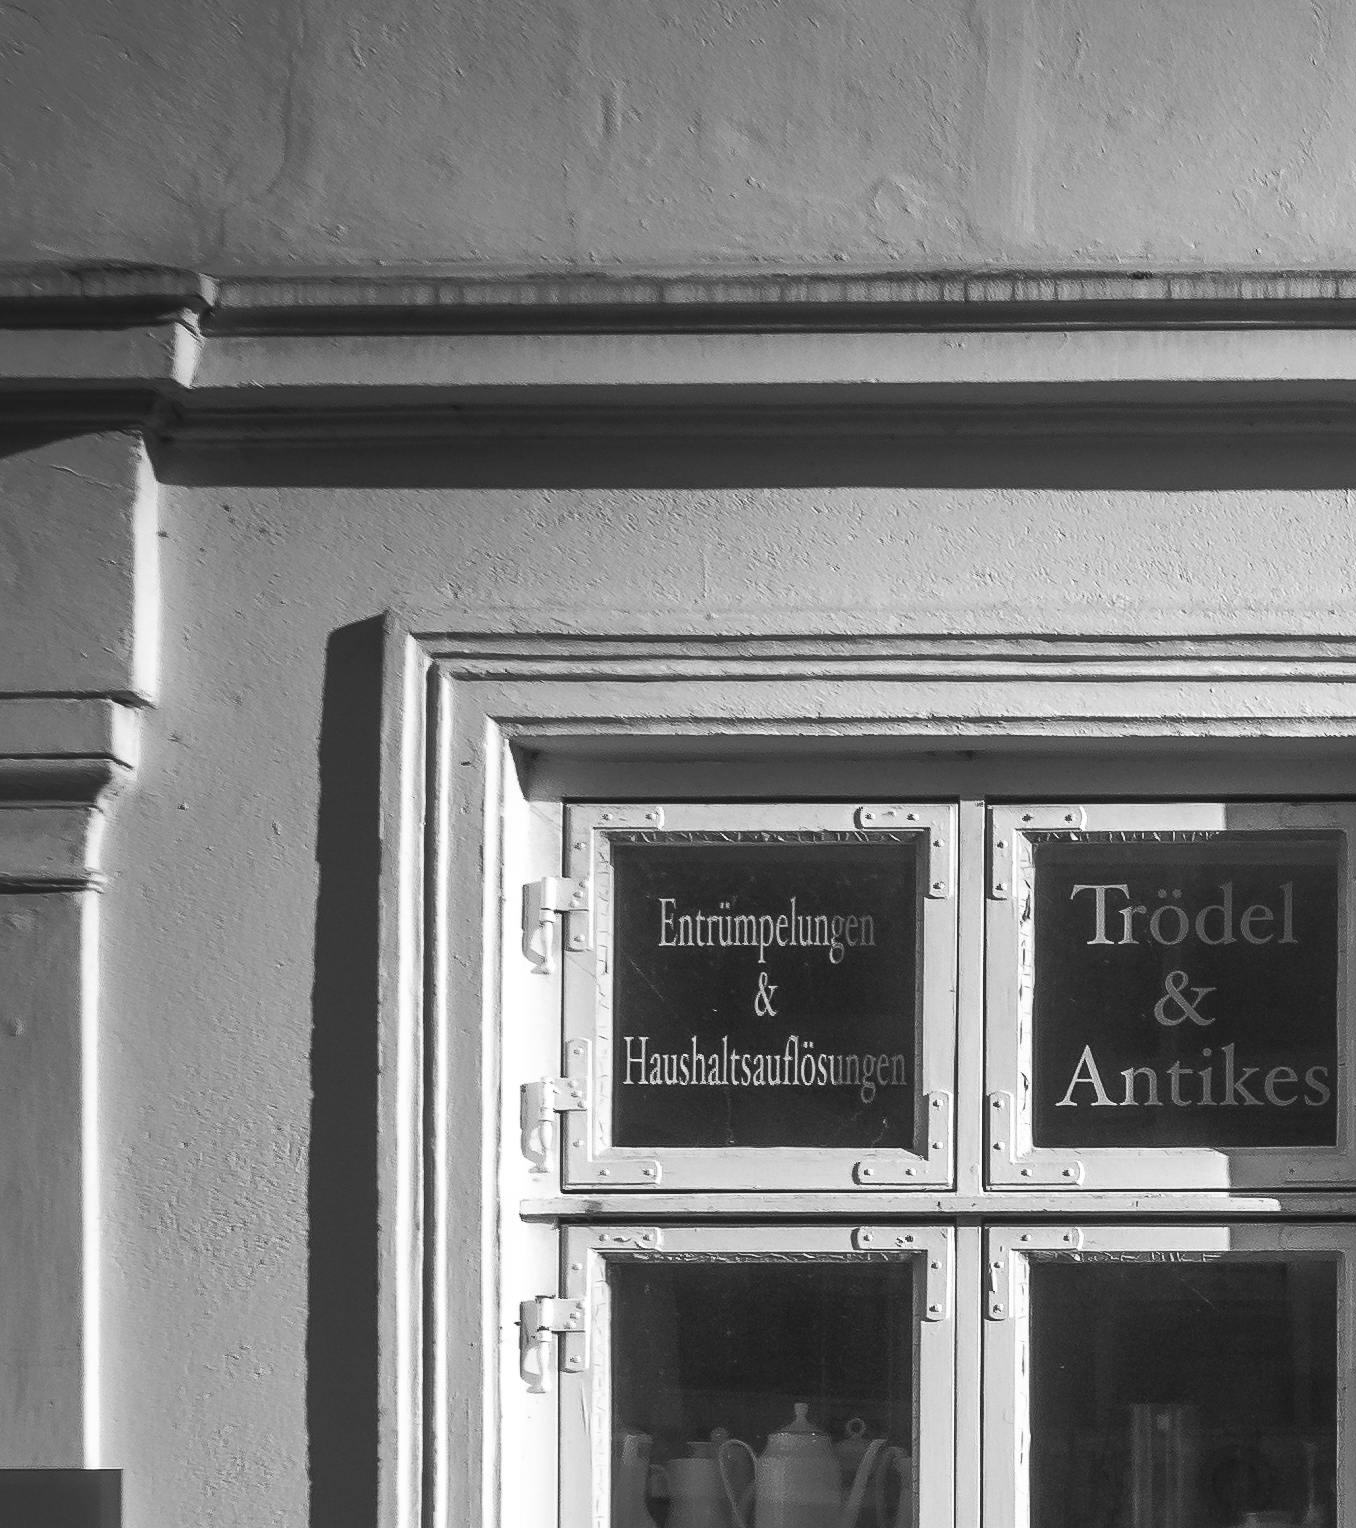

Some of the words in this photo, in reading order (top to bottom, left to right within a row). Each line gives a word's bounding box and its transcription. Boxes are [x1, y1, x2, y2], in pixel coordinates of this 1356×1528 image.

[657, 896, 875, 964] Entrümpelungen
[1069, 882, 1297, 946] Trödel
[753, 971, 779, 1017] &
[1153, 967, 1216, 1027] &
[622, 1033, 907, 1103] Haushaltsauflösungen
[1055, 1044, 1330, 1110] Antikes
